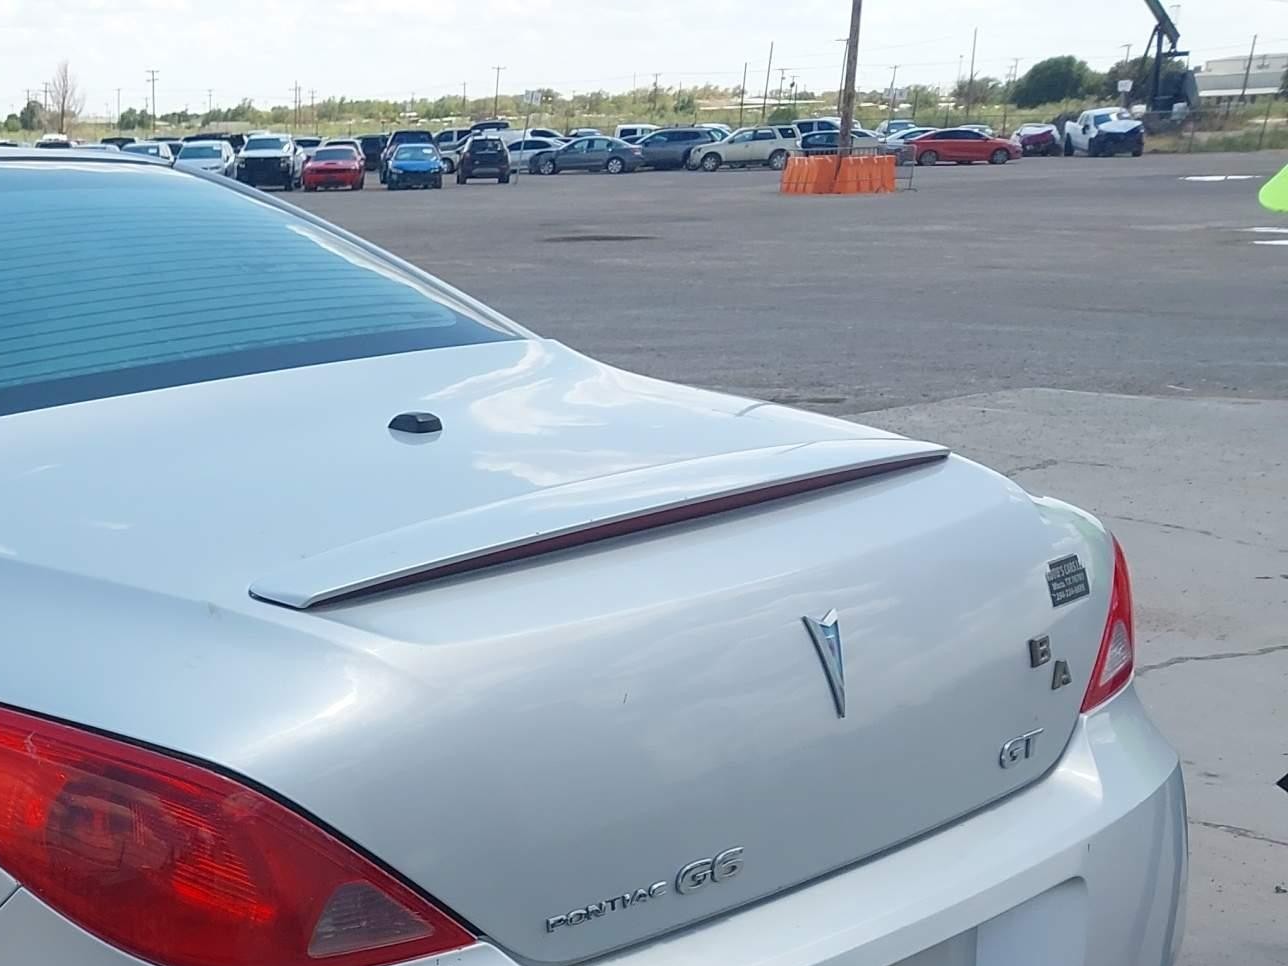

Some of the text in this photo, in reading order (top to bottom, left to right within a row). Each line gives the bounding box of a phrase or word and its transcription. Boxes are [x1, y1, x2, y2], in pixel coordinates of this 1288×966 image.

[1029, 634, 1052, 669] B
[1051, 660, 1073, 690] A
[999, 728, 1045, 769] GT
[544, 845, 745, 934] PONTIAC G6
